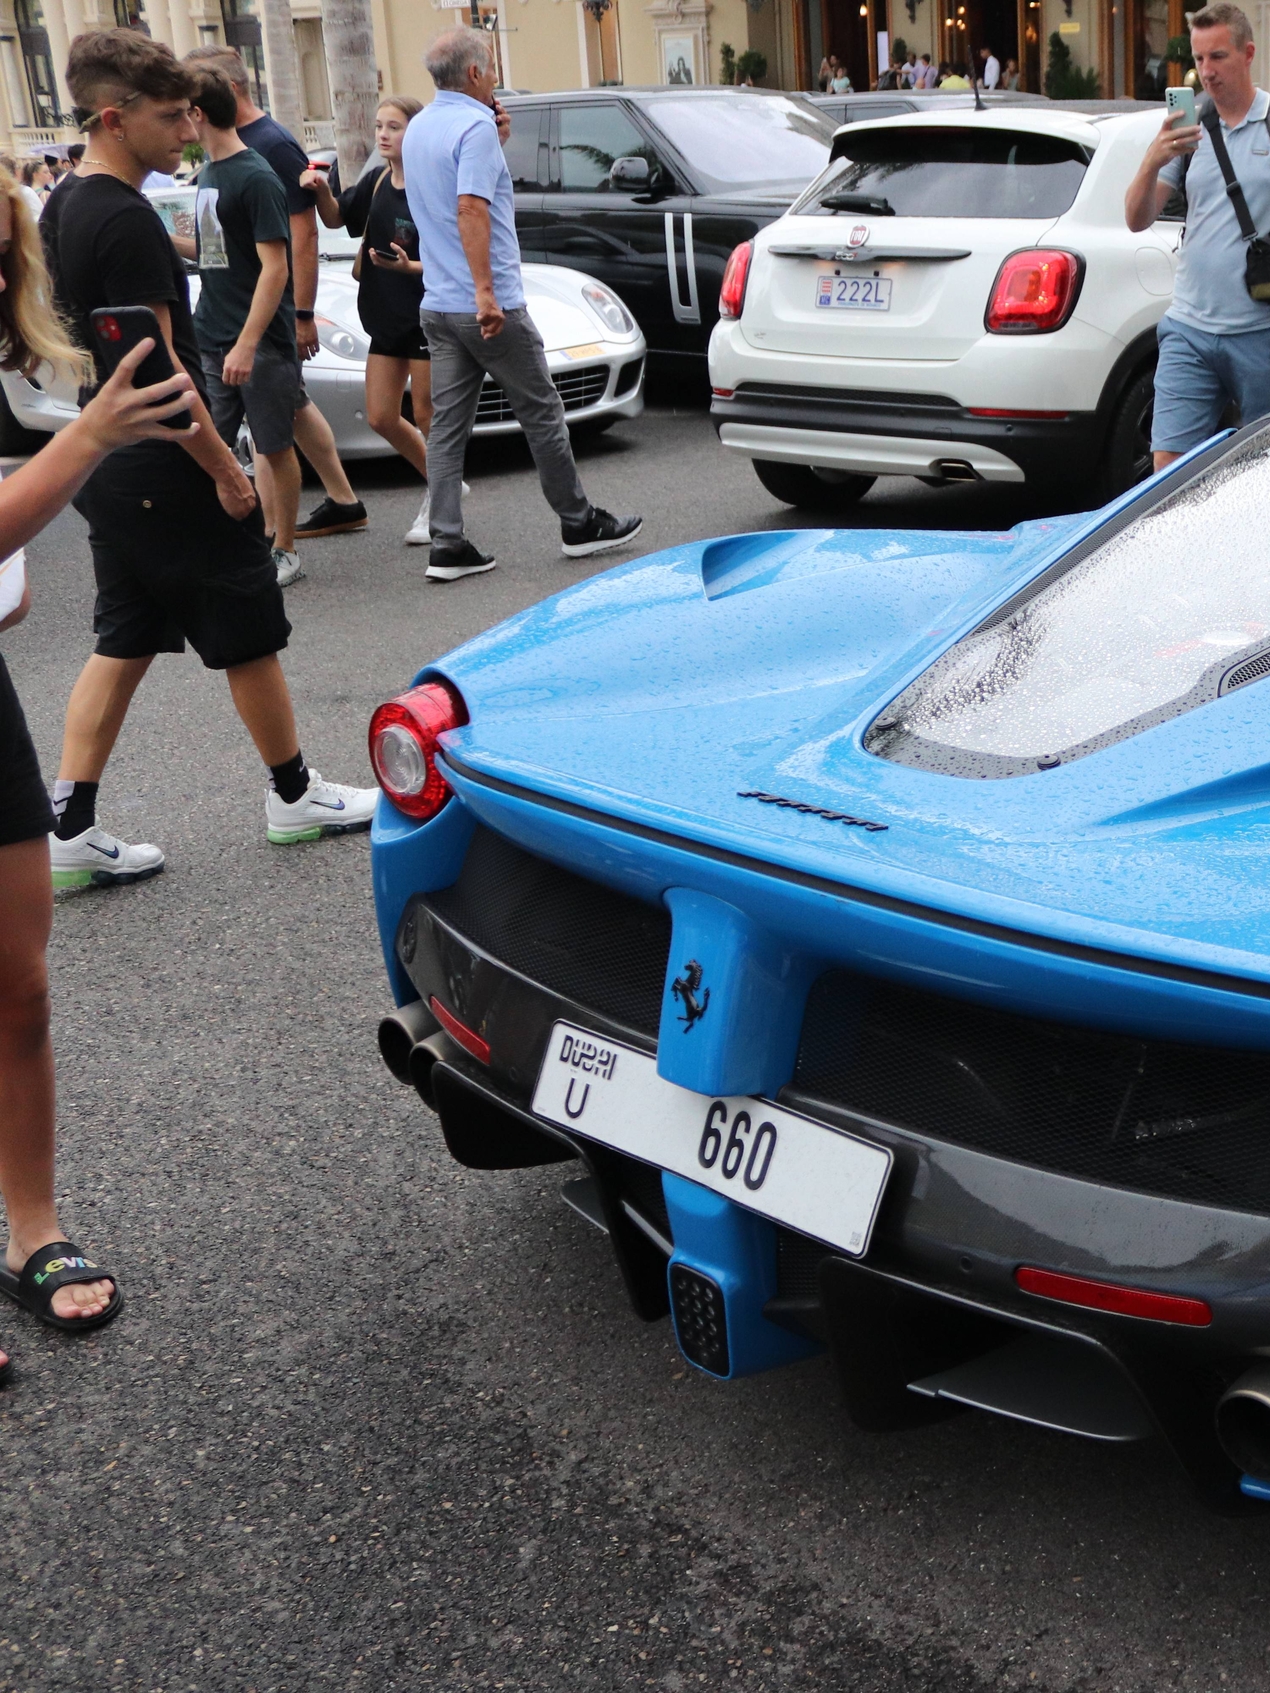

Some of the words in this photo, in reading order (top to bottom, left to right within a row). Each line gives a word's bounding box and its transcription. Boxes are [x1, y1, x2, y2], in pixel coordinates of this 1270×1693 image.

[836, 280, 884, 303] 222L
[564, 1077, 591, 1119] U
[699, 1100, 778, 1191] 660
